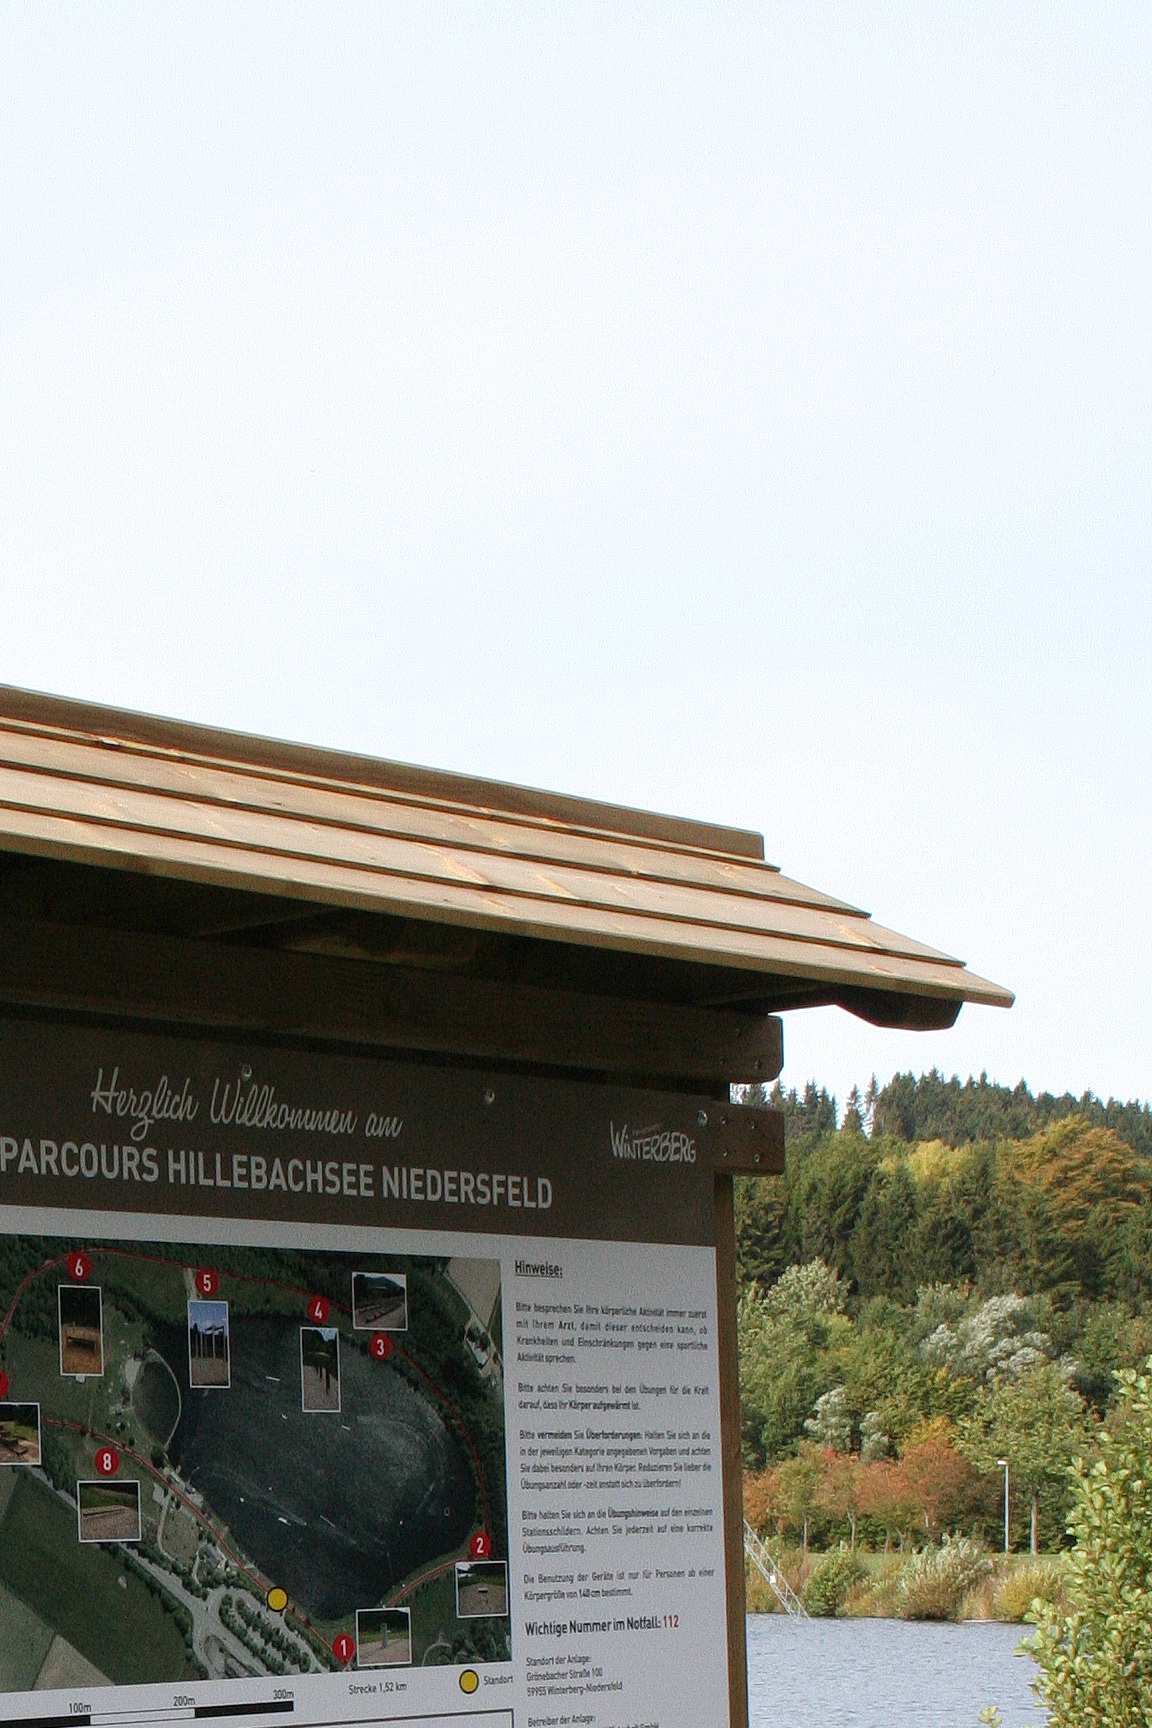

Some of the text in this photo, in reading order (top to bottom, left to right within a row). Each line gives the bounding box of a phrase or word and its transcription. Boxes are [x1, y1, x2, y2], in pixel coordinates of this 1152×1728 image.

[89, 1065, 403, 1146] Herzlich Willkommen am
[168, 1149, 374, 1197] HILLEBACHSEE
[382, 1165, 552, 1209] NIEDERSFELD
[514, 1260, 562, 1278] Hinweise:
[525, 1620, 567, 1639] Wichtige
[569, 1618, 612, 1633] Nummer
[613, 1620, 624, 1630] im
[663, 1614, 678, 1628] 112
[272, 1688, 294, 1699] 300m
[348, 1682, 376, 1695] Strecke
[395, 1681, 406, 1691] km
[69, 1701, 91, 1713] 100m
[173, 1694, 195, 1706] 200m
